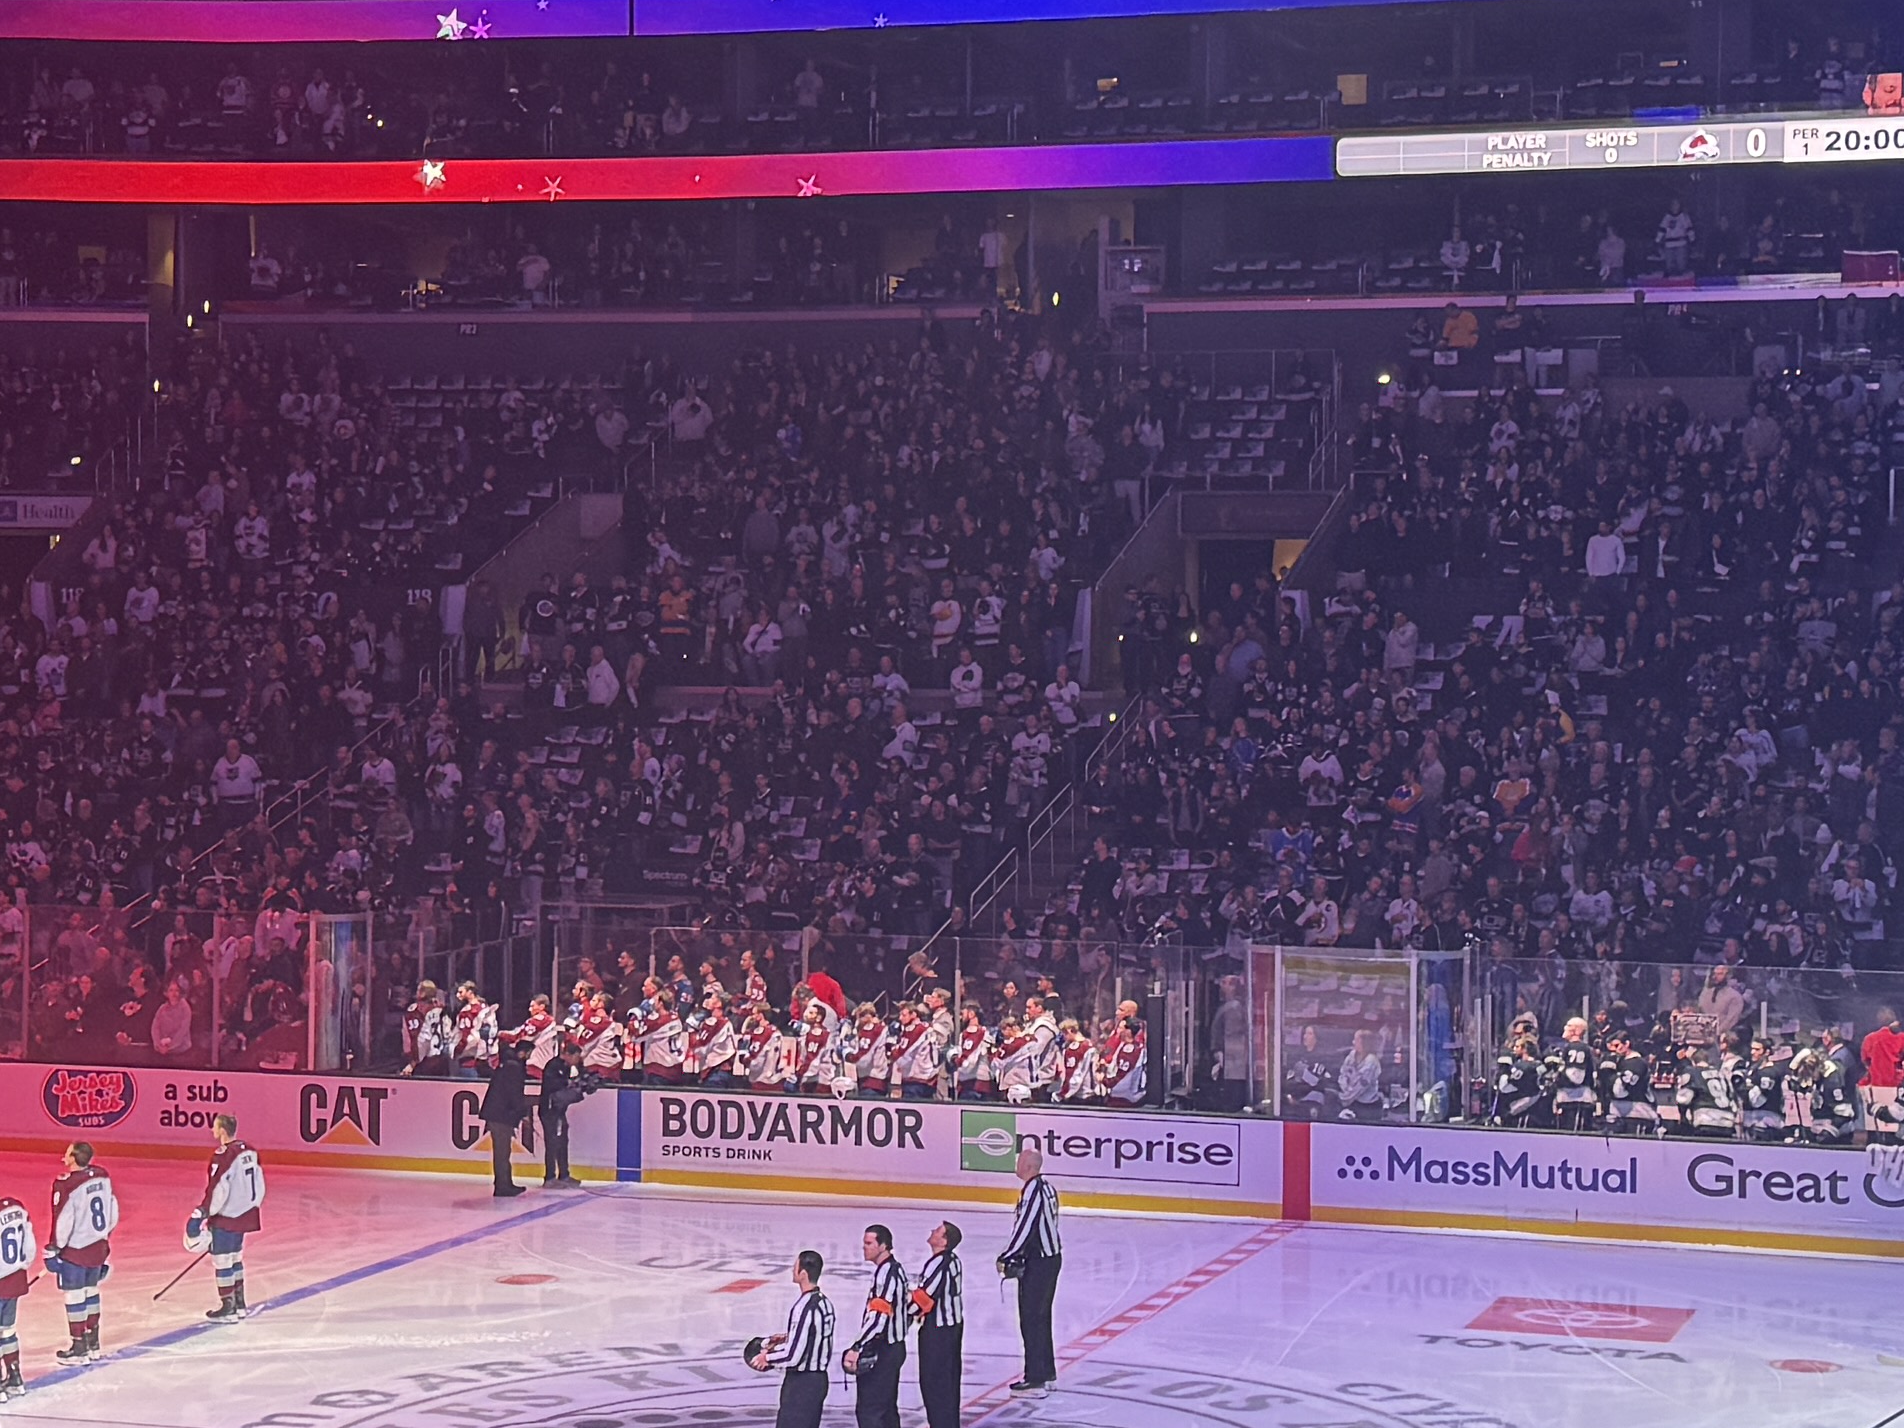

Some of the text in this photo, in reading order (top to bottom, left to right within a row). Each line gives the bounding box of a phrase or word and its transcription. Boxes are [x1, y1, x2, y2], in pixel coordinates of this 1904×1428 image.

[1487, 132, 1547, 150] PLAYER
[1585, 130, 1639, 148] SHOTS
[1745, 128, 1767, 157] 0
[1793, 128, 1820, 141] PER
[1803, 142, 1810, 156] 1
[1482, 151, 1553, 169] PENALTY
[1604, 145, 1618, 163] 0
[21, 503, 77, 520] Health
[642, 869, 689, 884] Spectrum
[49, 1068, 126, 1100] Jersey
[164, 1079, 229, 1104] a sub
[56, 1089, 126, 1119] Mike's
[300, 1083, 383, 1146] CAT
[77, 1114, 107, 1128] SUBS
[660, 1097, 925, 1150] BODYARMOR
[661, 1144, 773, 1162] SPORTS DRINK
[954, 1126, 1235, 1176] enterprise
[244, 1166, 256, 1203] 7
[1387, 1145, 1638, 1196] MassMutual
[1687, 1153, 1850, 1206] Great
[90, 1196, 106, 1233] 8
[1, 1222, 27, 1265] 62
[1417, 1333, 1690, 1364] TOYOTA
